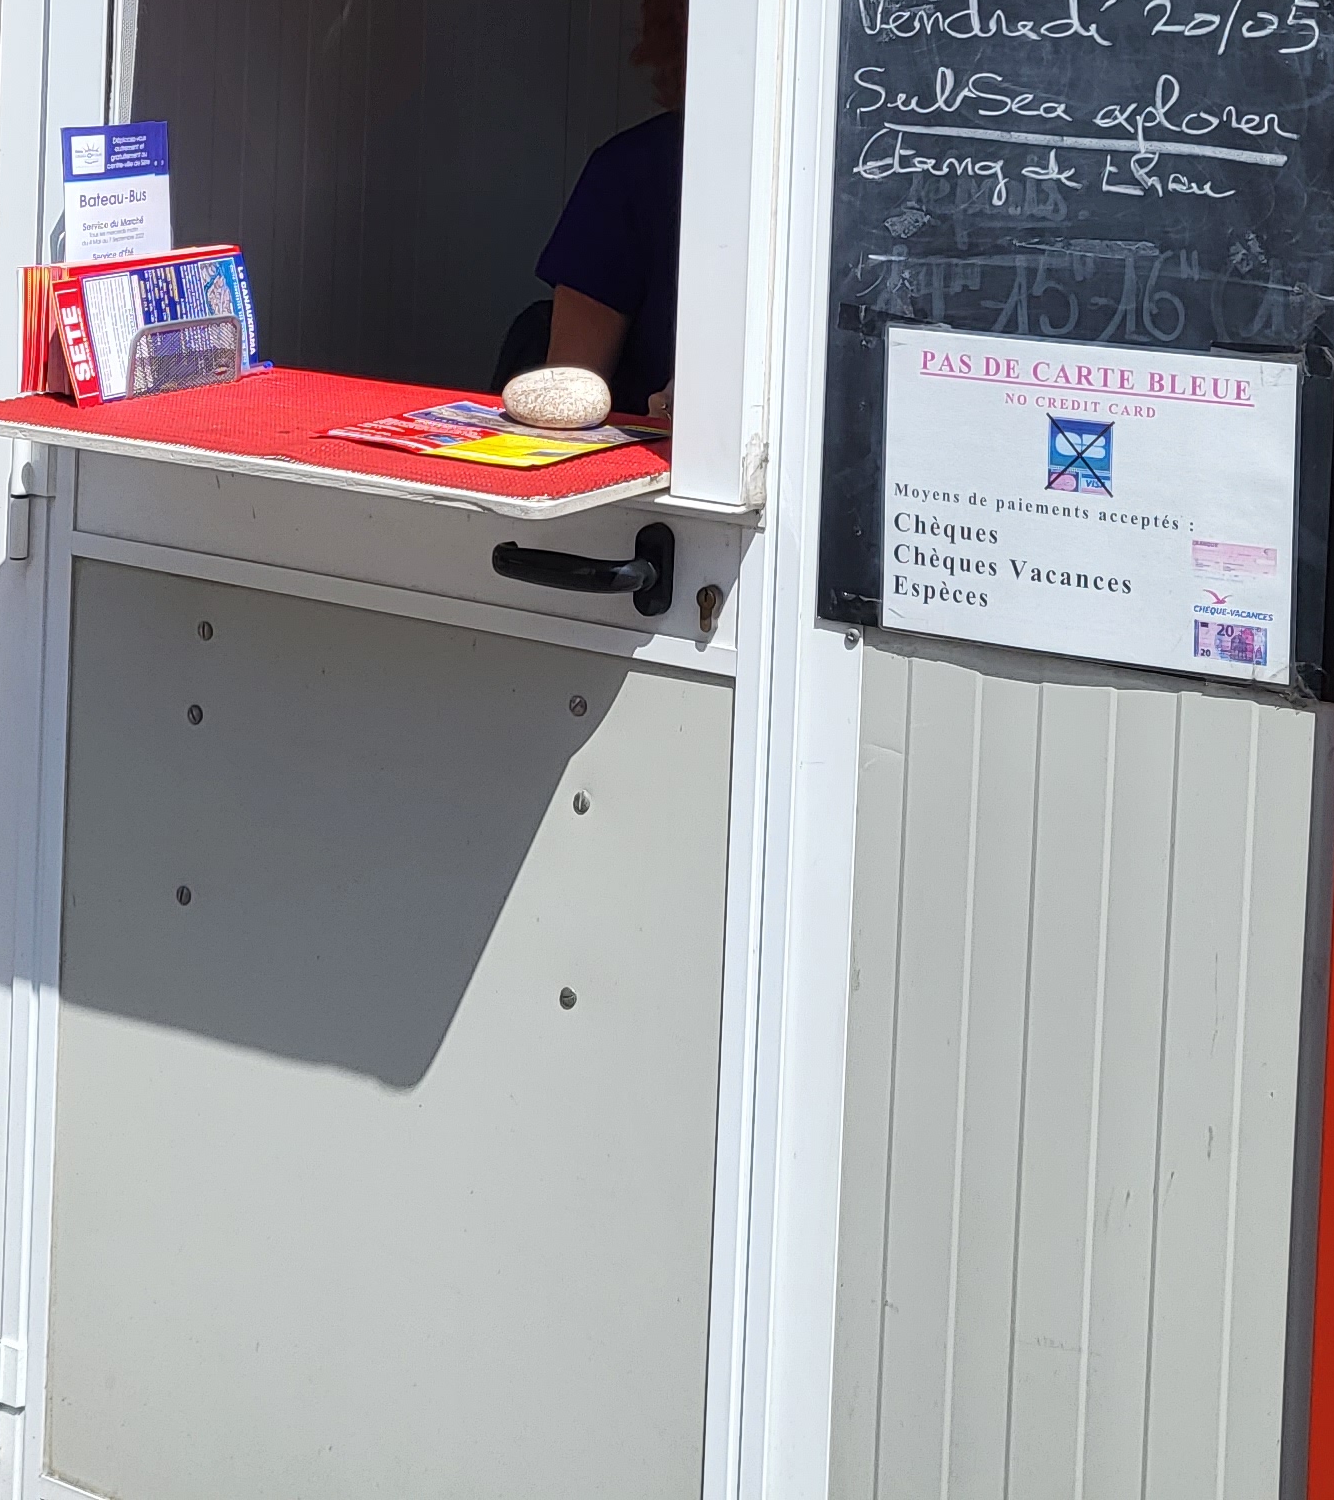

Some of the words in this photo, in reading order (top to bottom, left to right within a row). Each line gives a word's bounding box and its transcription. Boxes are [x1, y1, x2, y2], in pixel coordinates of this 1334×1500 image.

[1021, 149, 1082, 189] de
[79, 190, 147, 208] Bateau-Bus
[63, 305, 92, 382] SETE
[921, 351, 972, 374] PAS
[984, 356, 1020, 379] DE
[1032, 361, 1135, 390] CARTE
[1147, 372, 1252, 401] BLEUE
[1005, 393, 1027, 405] NO
[1036, 396, 1100, 413] CREDIT
[1109, 403, 1156, 418] CARD
[894, 482, 960, 502] Moyens
[969, 492, 987, 506] de
[996, 498, 1089, 519] paiements
[1099, 511, 1179, 531] acceptés
[893, 512, 998, 544] Chèques
[893, 543, 997, 576] Chèques
[1009, 559, 1132, 594] Vacances
[893, 574, 988, 607] Espèces
[1217, 624, 1234, 637] 20
[1200, 648, 1211, 657] 20
